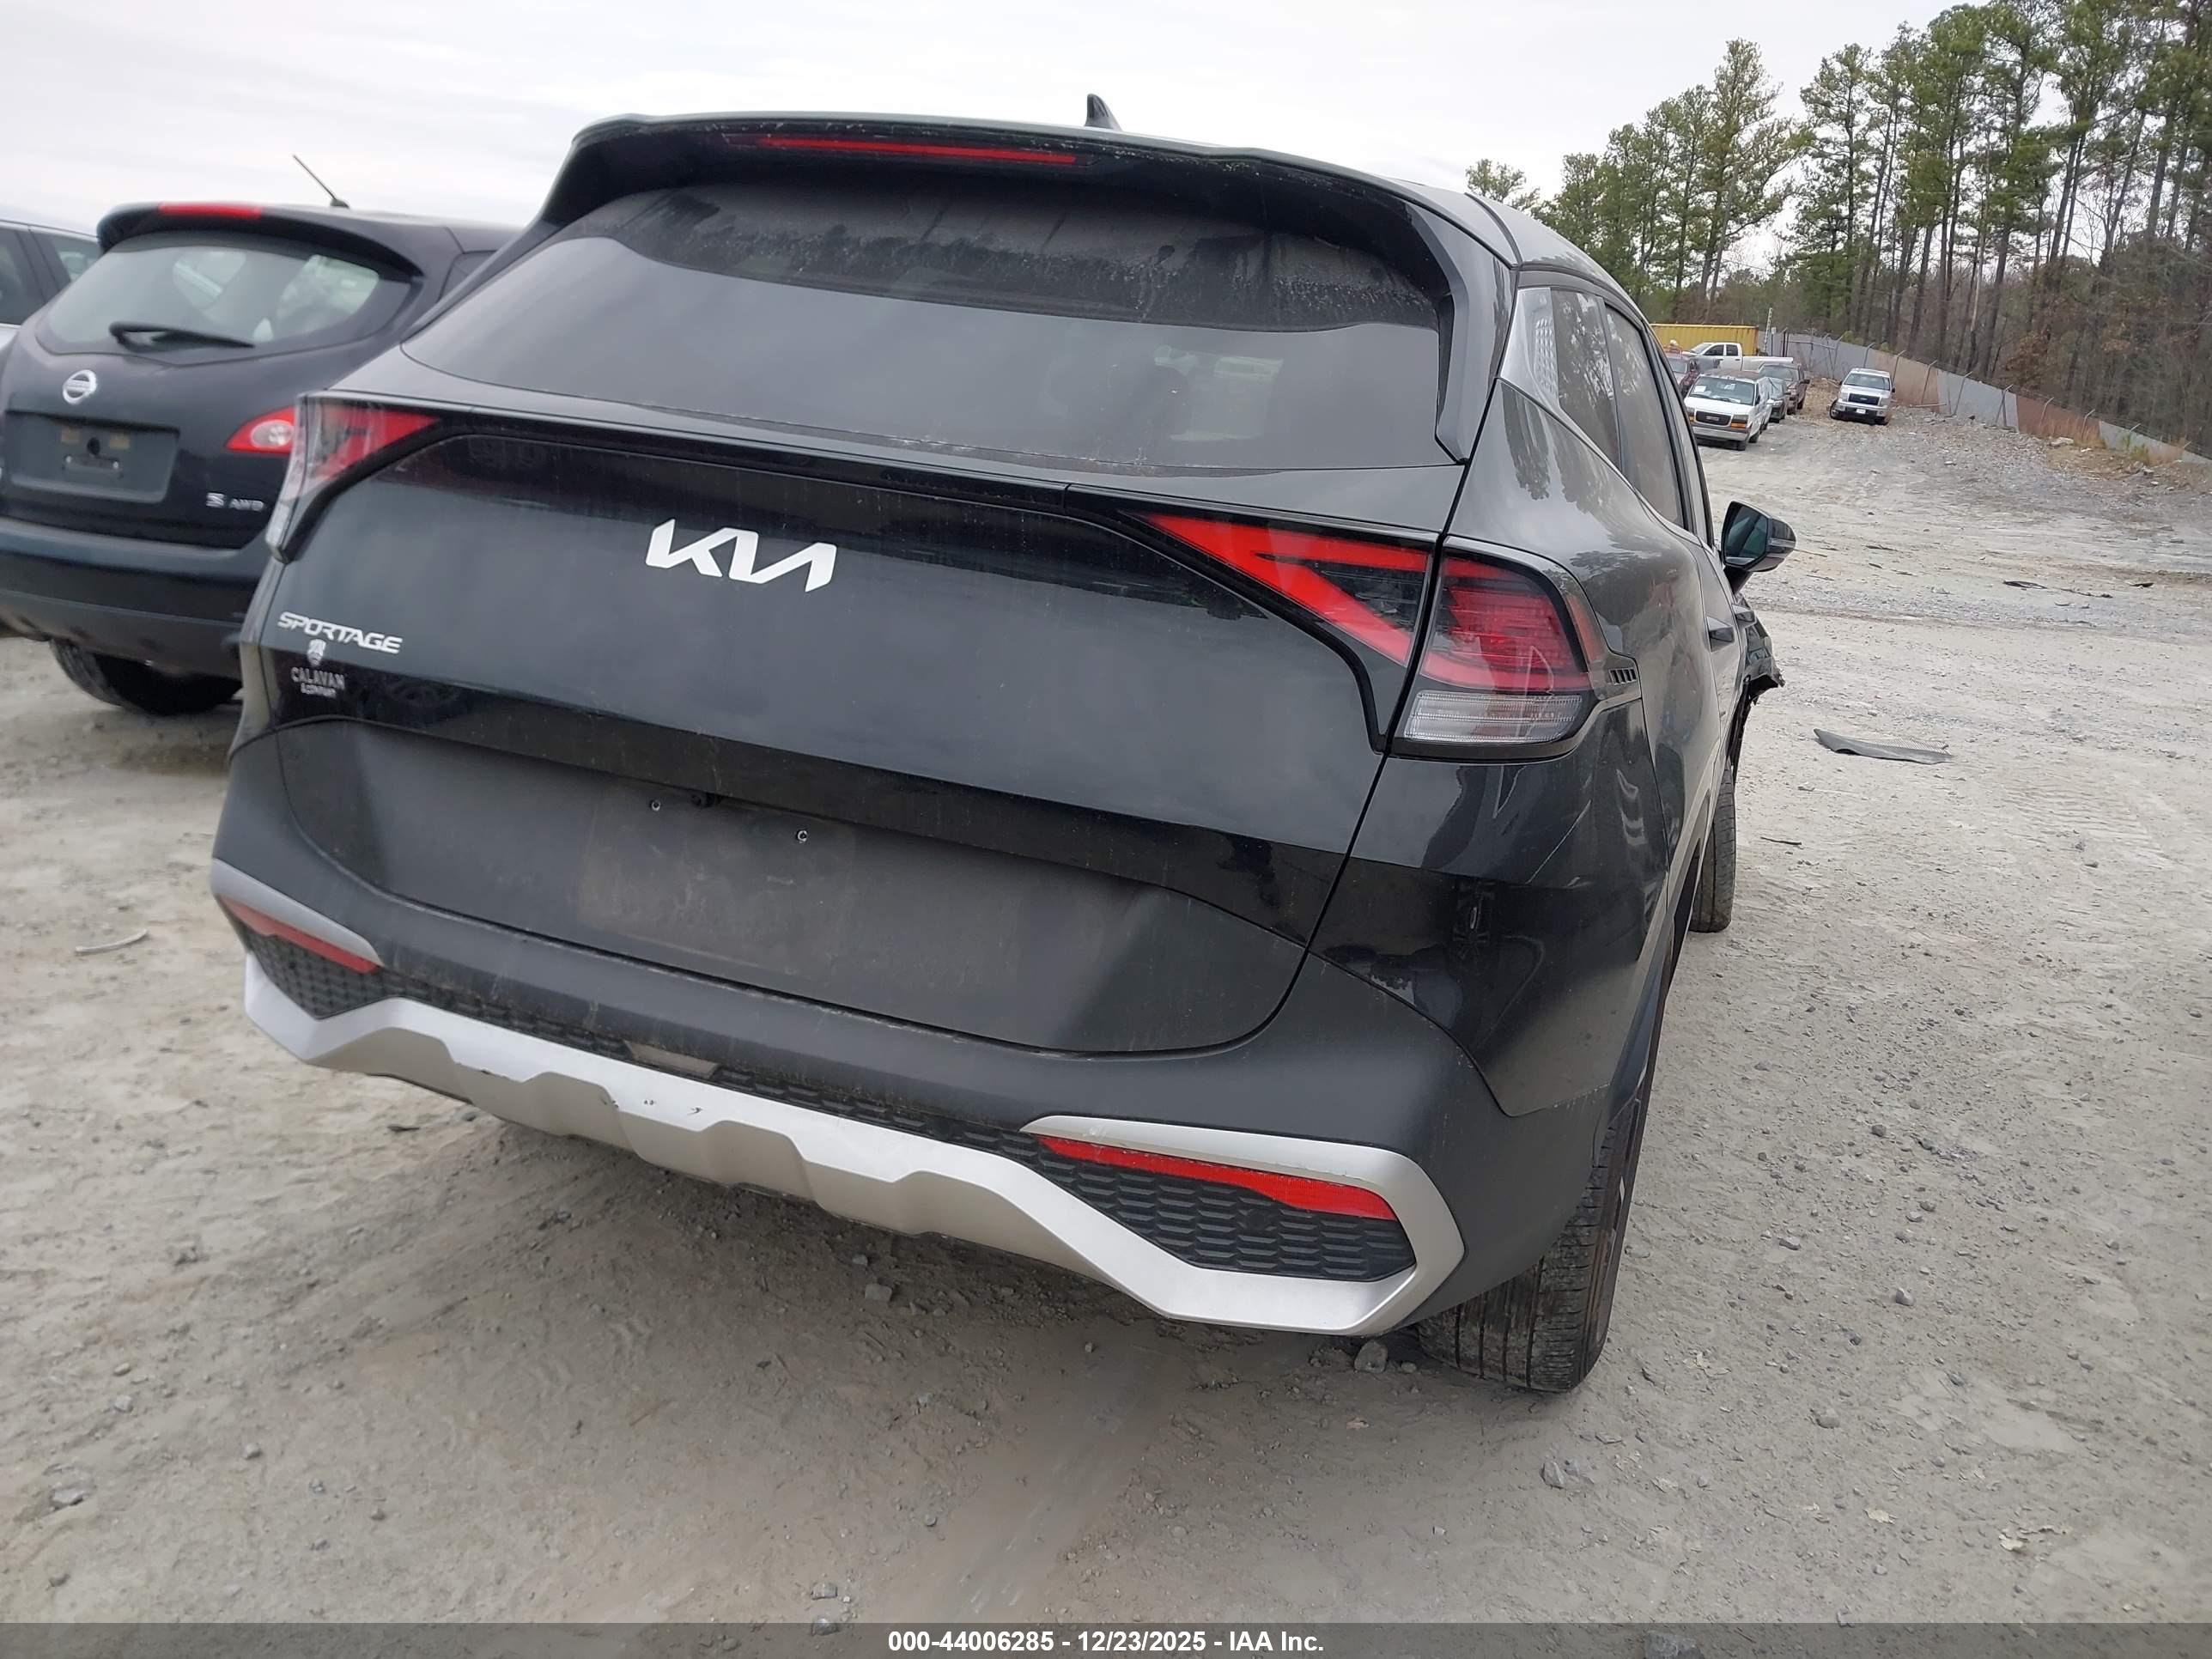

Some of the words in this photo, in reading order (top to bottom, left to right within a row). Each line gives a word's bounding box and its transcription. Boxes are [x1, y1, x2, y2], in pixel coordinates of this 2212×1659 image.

[230, 498, 264, 512] AWD
[646, 519, 837, 592] KIA
[277, 611, 404, 654] SPORTAGE
